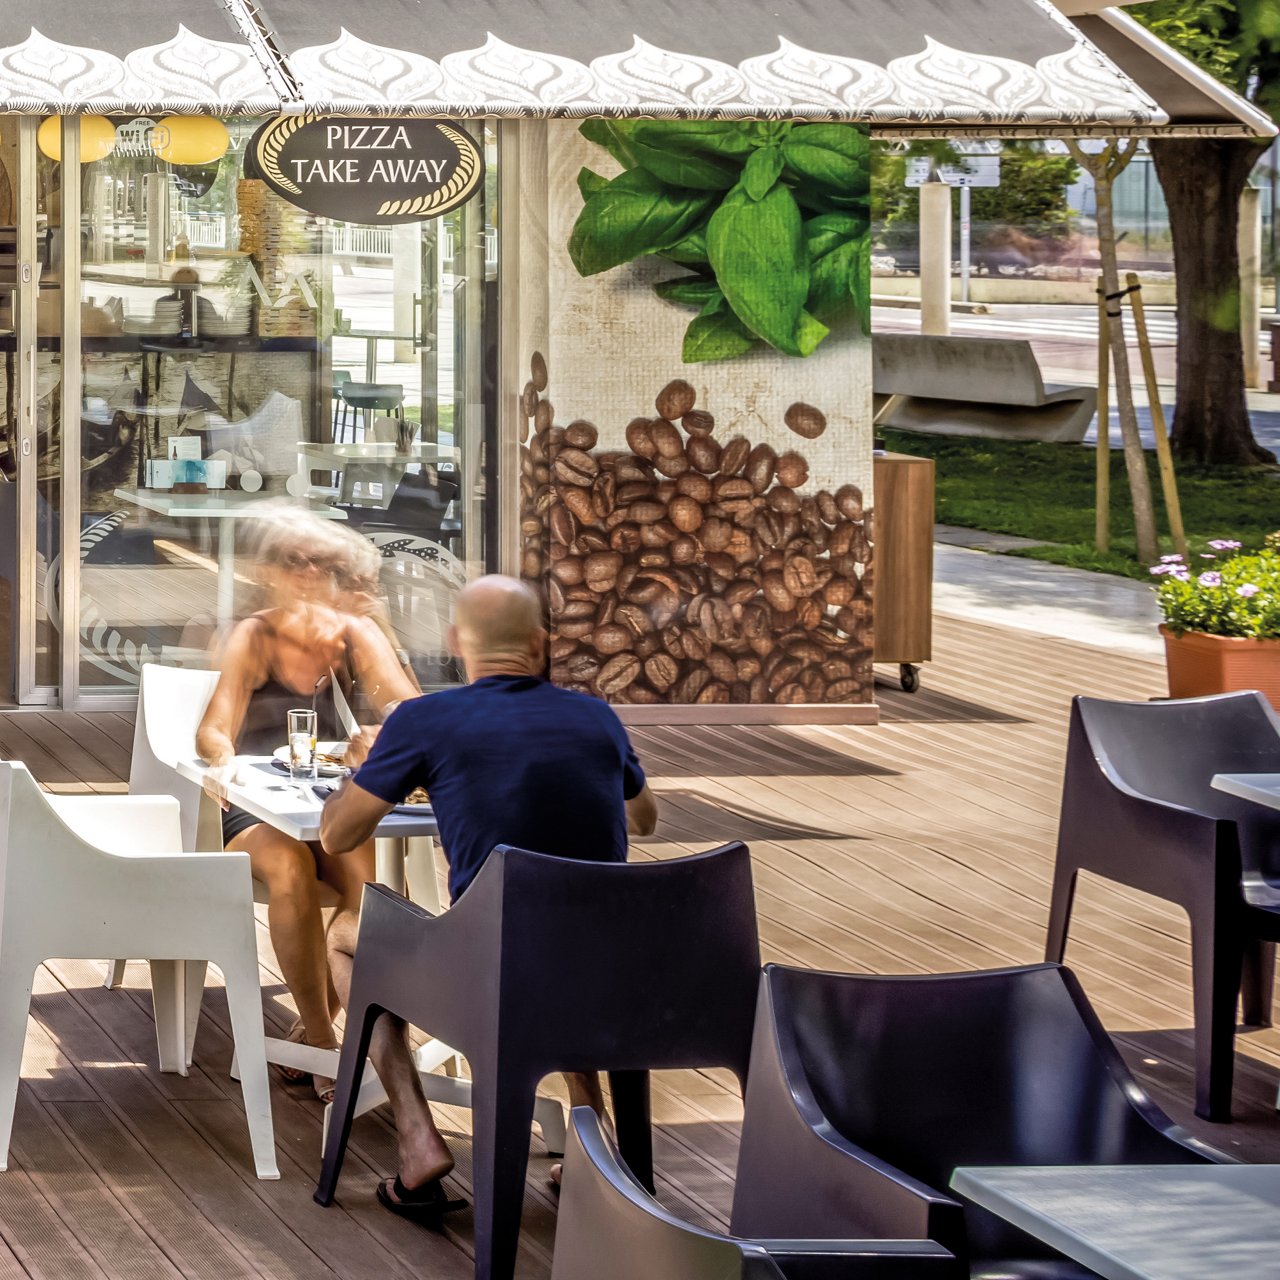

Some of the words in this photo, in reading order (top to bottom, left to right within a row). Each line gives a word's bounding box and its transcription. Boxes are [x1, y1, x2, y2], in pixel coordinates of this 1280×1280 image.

[326, 125, 412, 150] PIZZA
[291, 159, 359, 183] TAKE
[368, 159, 448, 183] AWAY
